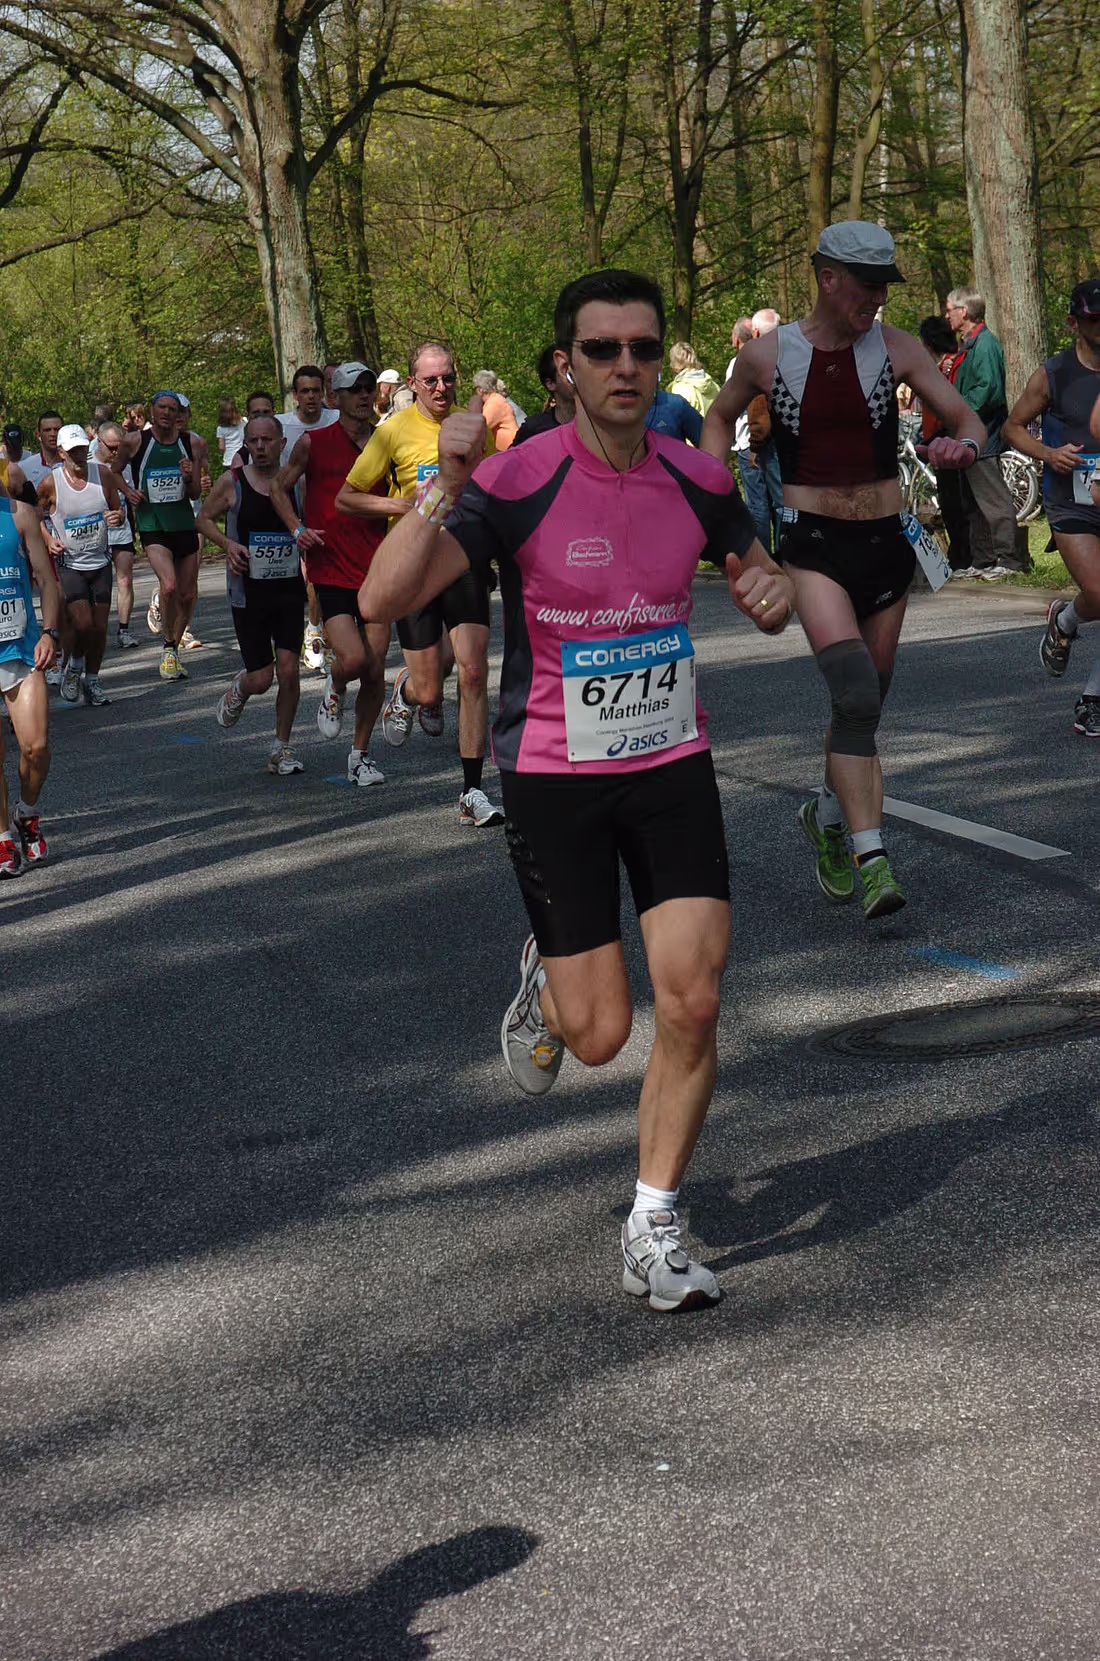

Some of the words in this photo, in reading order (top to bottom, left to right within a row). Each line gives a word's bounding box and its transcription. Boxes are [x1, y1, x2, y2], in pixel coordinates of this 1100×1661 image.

[152, 477, 181, 488] 3524
[70, 522, 99, 538] 20414
[255, 544, 293, 559] 5513
[575, 634, 681, 667] CONERGY
[581, 660, 678, 707] 6714
[599, 698, 670, 721] Matthias
[629, 730, 669, 751] asics
